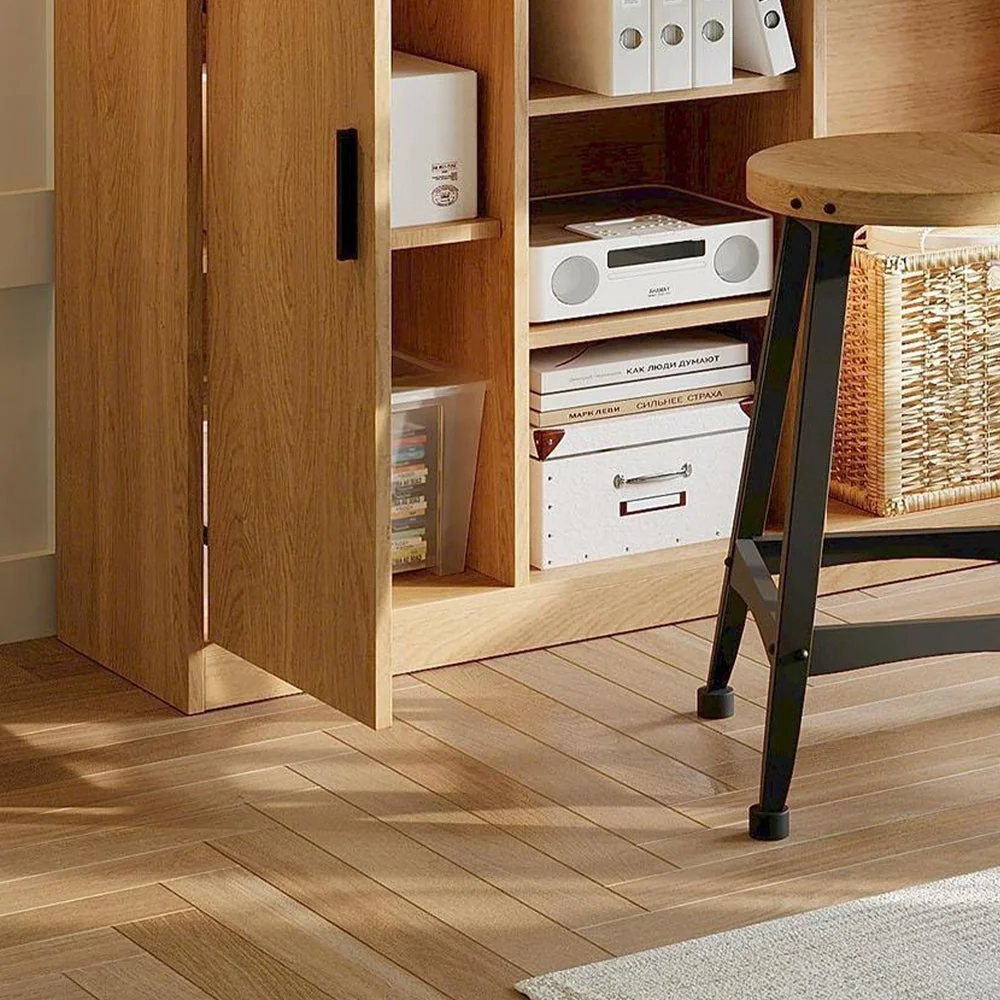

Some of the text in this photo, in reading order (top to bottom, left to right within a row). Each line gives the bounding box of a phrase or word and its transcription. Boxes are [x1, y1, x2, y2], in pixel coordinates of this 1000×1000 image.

[626, 365, 646, 376] КАК
[647, 360, 677, 373] ЛЮДИ
[679, 355, 720, 369] ДУМАЮТ
[636, 390, 723, 410] СИЛЬНЕЕ СТРАХА
[568, 406, 621, 420] МАРК ЛЕВИ
